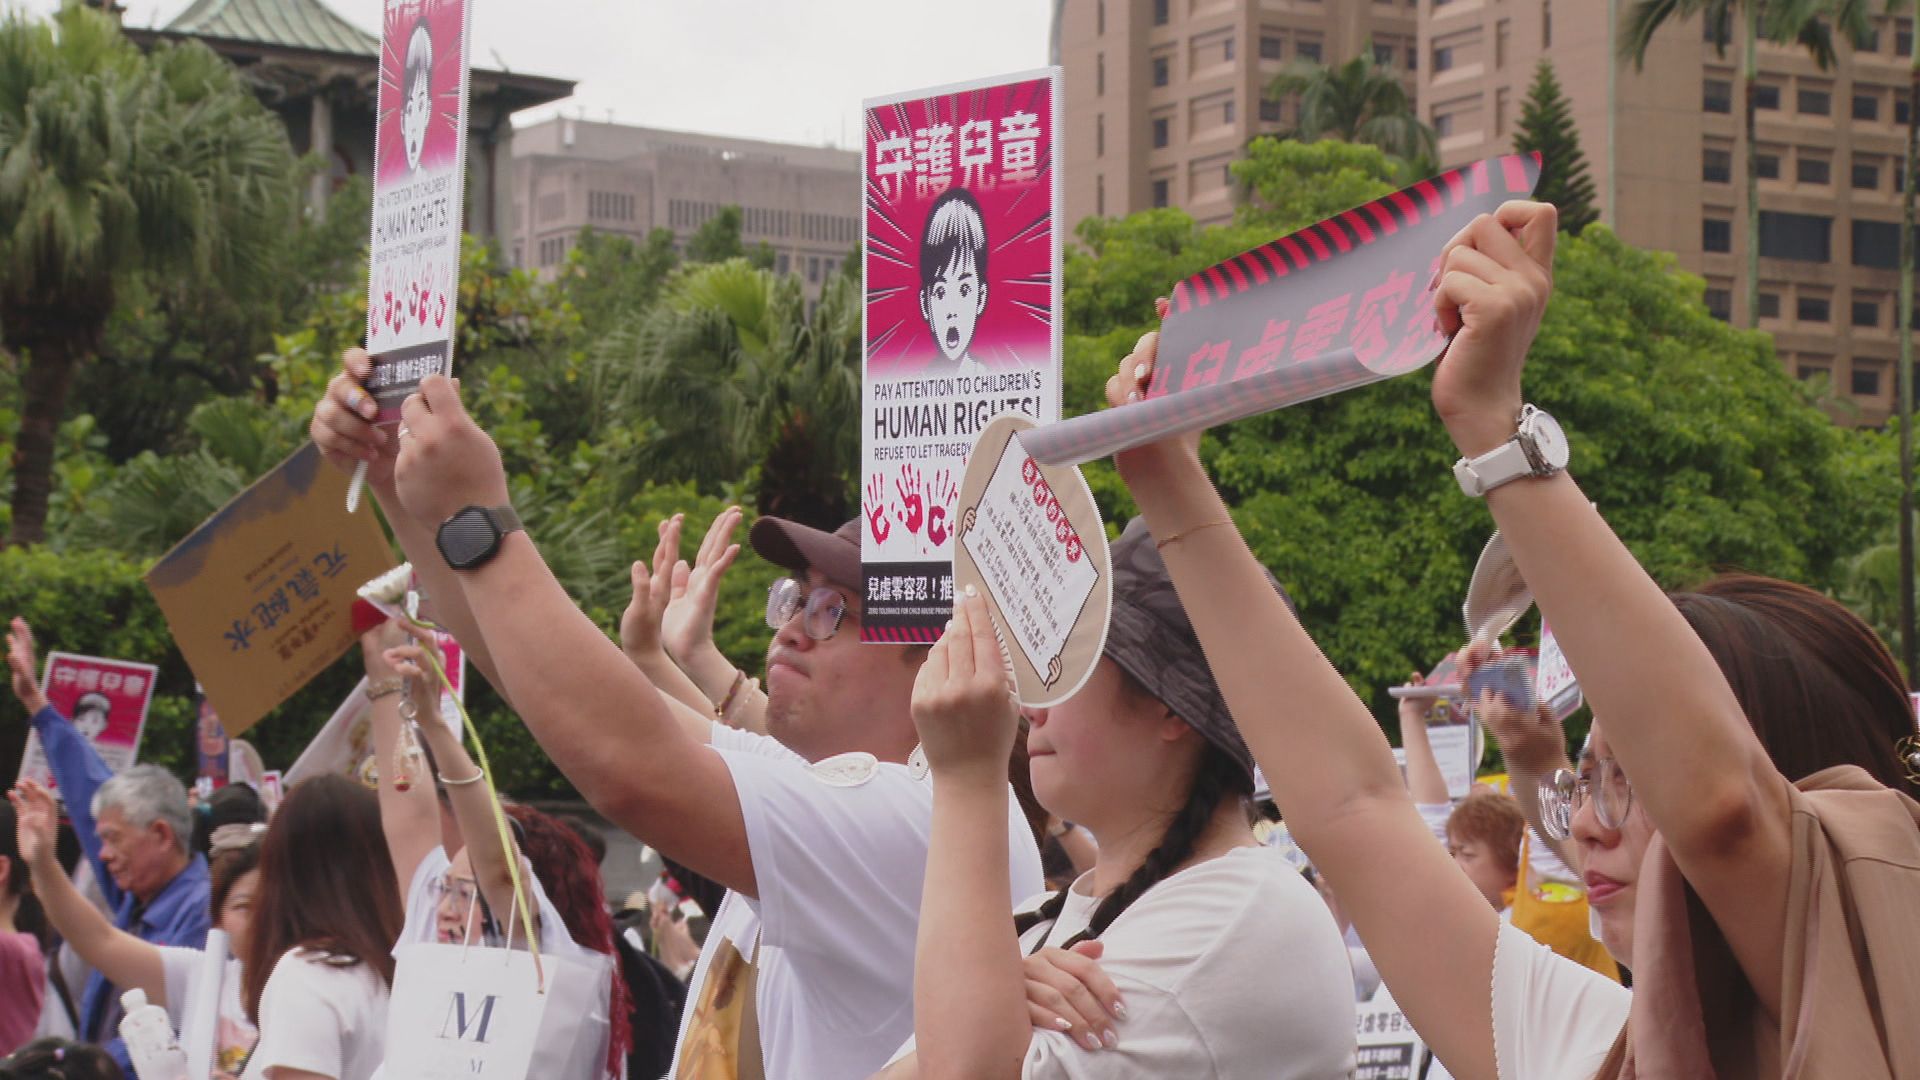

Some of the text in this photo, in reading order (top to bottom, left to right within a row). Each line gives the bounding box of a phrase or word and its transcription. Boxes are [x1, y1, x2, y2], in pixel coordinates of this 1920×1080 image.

[875, 110, 1042, 202] 守護兒童
[874, 370, 1042, 400] PAY ATTENTION TO CHILDREN'S
[874, 403, 947, 440] HUMAN
[874, 442, 972, 461] REFUSE TO LET TRAGEDY
[867, 575, 953, 601] 兒虐零容忍！推
[435, 991, 503, 1043] M
[1356, 1011, 1412, 1034] 虐零容
